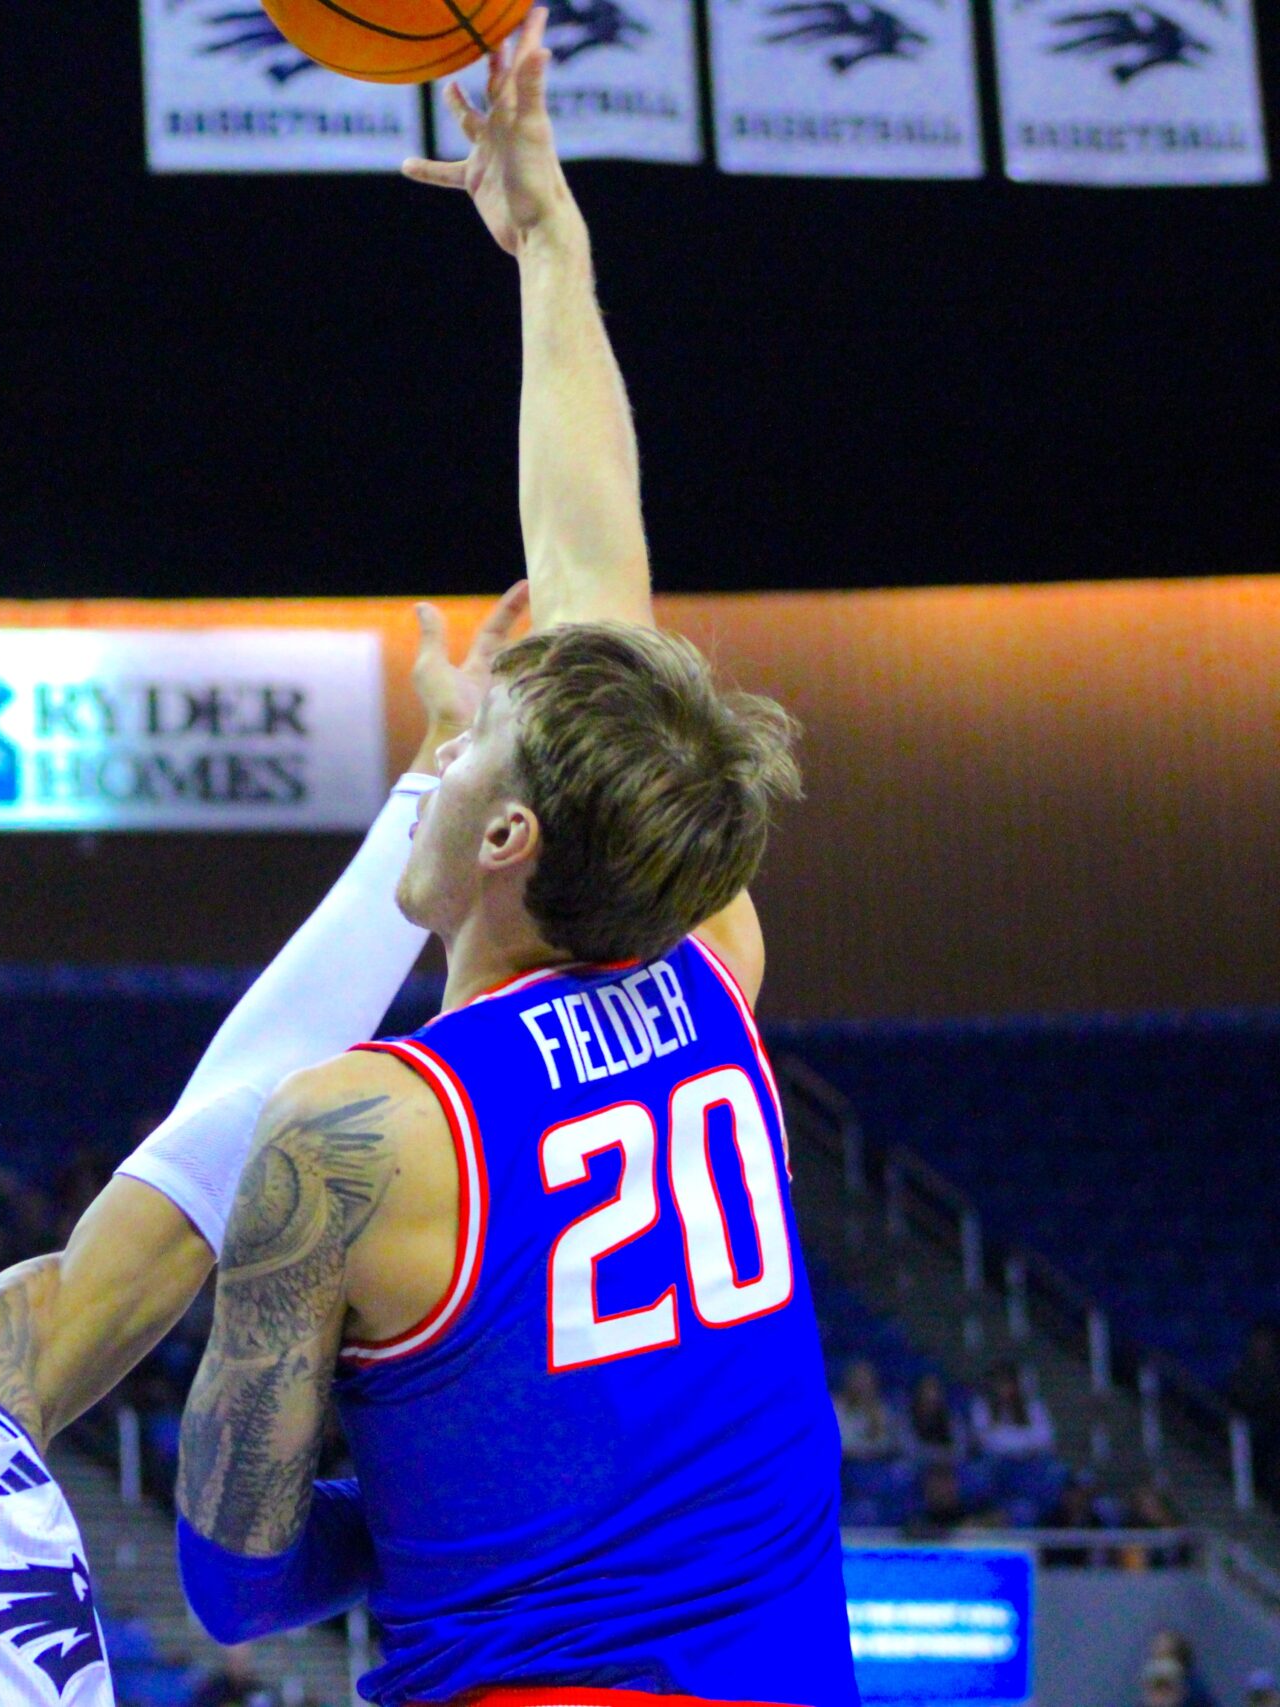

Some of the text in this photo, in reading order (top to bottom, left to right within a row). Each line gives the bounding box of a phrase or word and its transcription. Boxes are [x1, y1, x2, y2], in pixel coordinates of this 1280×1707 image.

[166, 107, 404, 136] BASKETBALL
[734, 114, 961, 142] BASKETBALL
[1022, 123, 1247, 151] BASKETBALL
[34, 684, 308, 737] RYDER
[35, 752, 307, 803] HOMES
[519, 960, 698, 1090] FIELDER
[538, 1063, 794, 1374] 20
